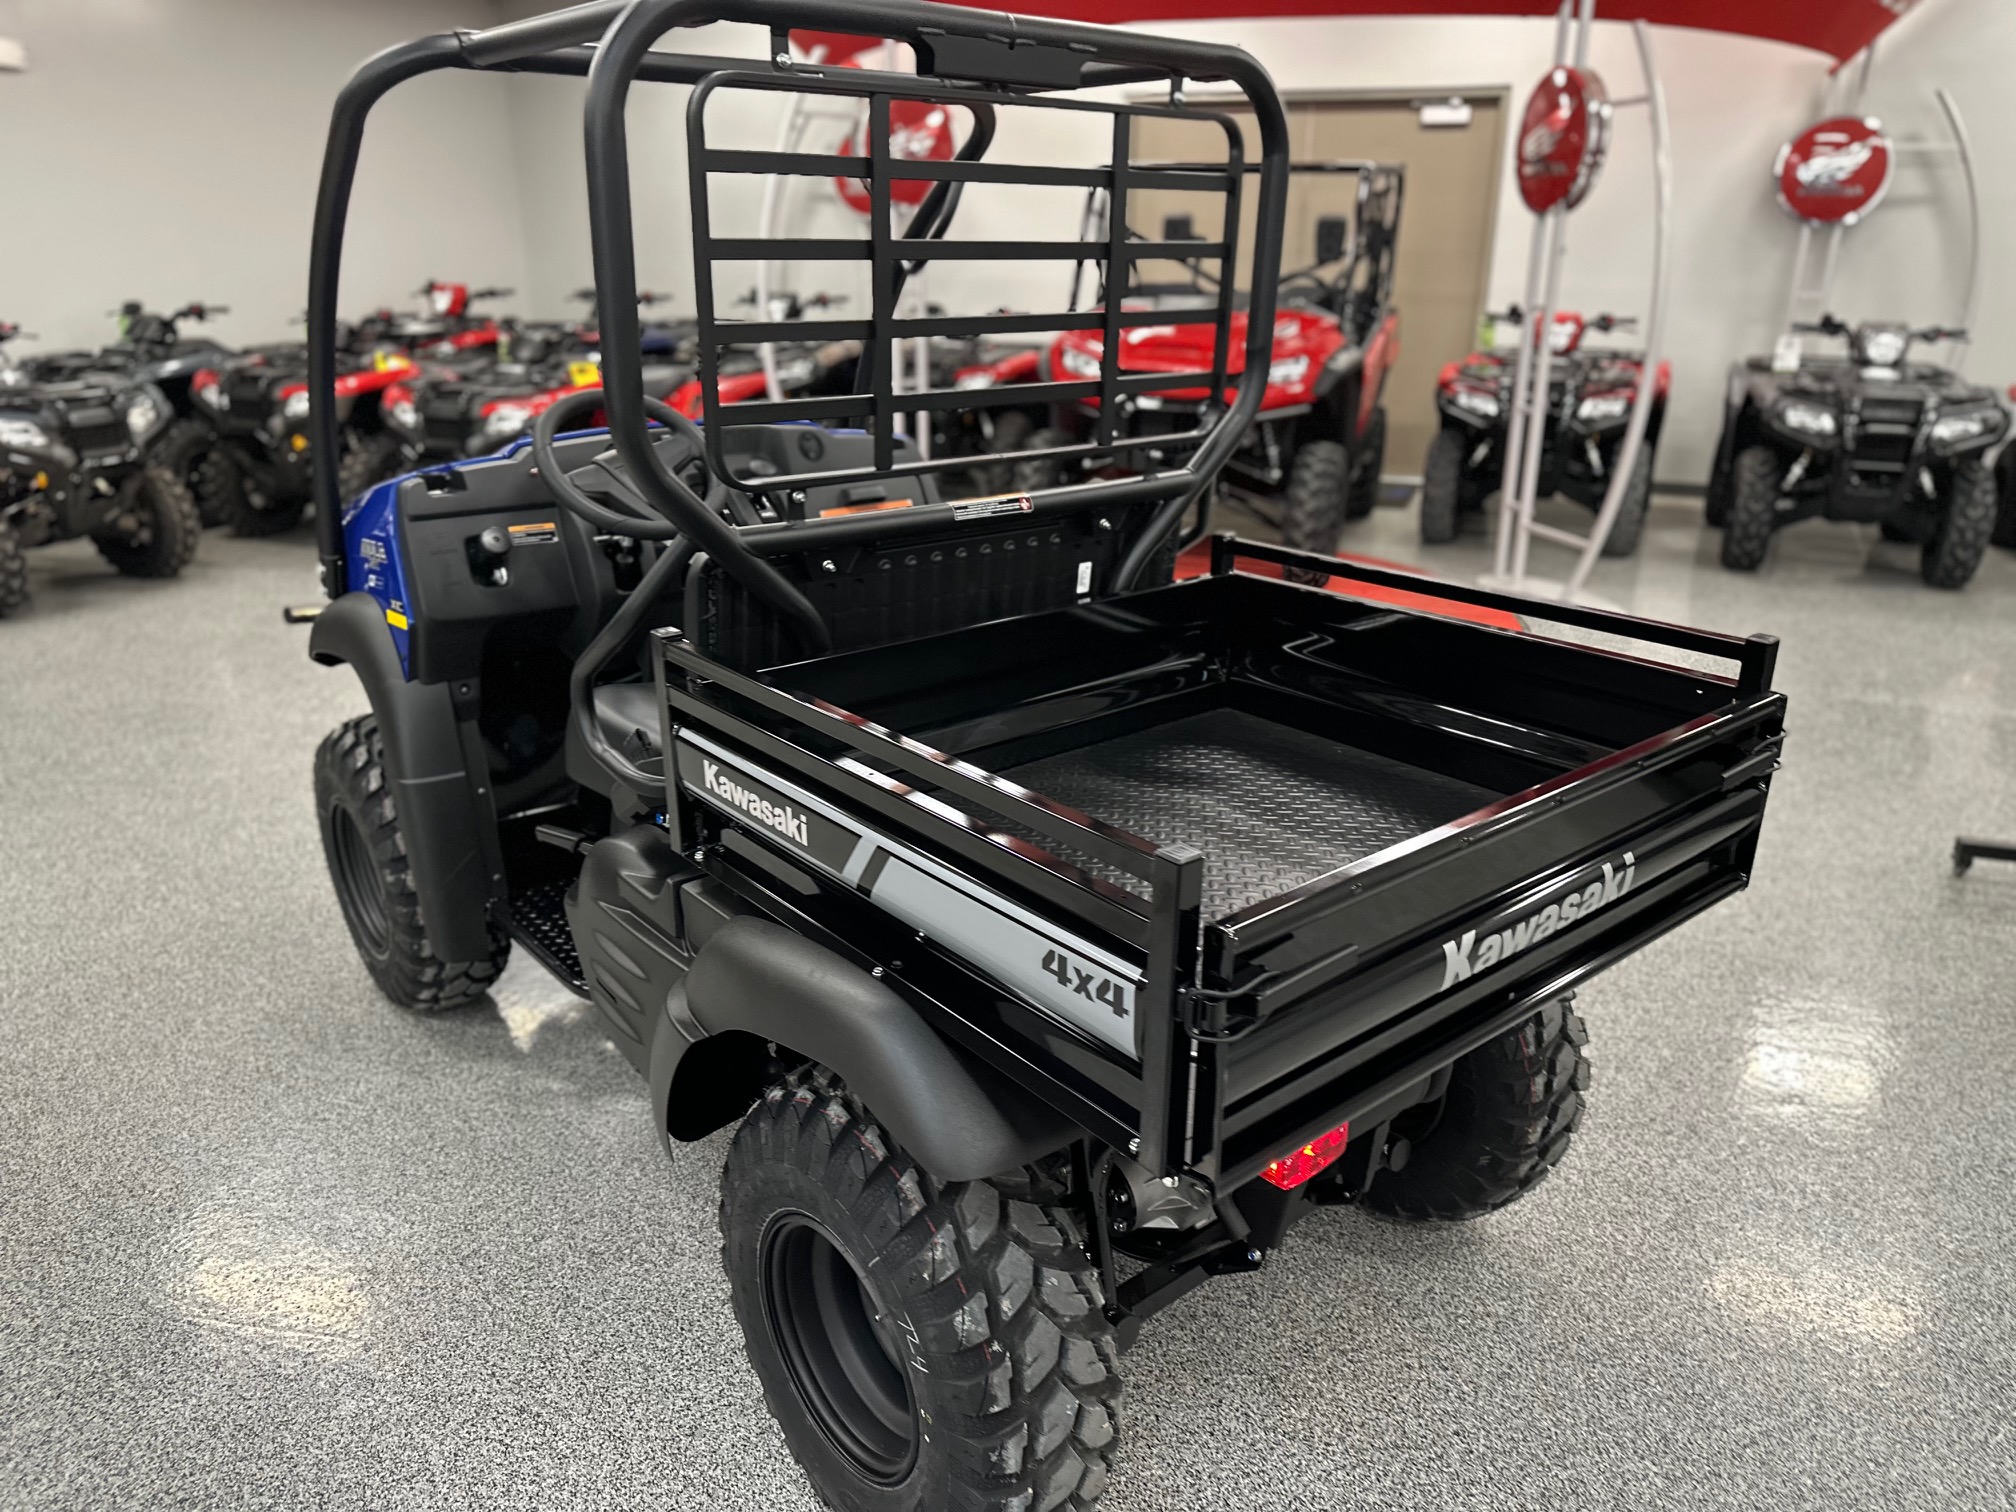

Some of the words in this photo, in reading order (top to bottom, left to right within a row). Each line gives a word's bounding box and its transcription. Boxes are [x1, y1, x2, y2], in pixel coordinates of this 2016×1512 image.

[703, 759, 808, 847] Kawasaki
[1441, 851, 1636, 991] Kawasaki
[1042, 949, 1130, 1019] 4x4
